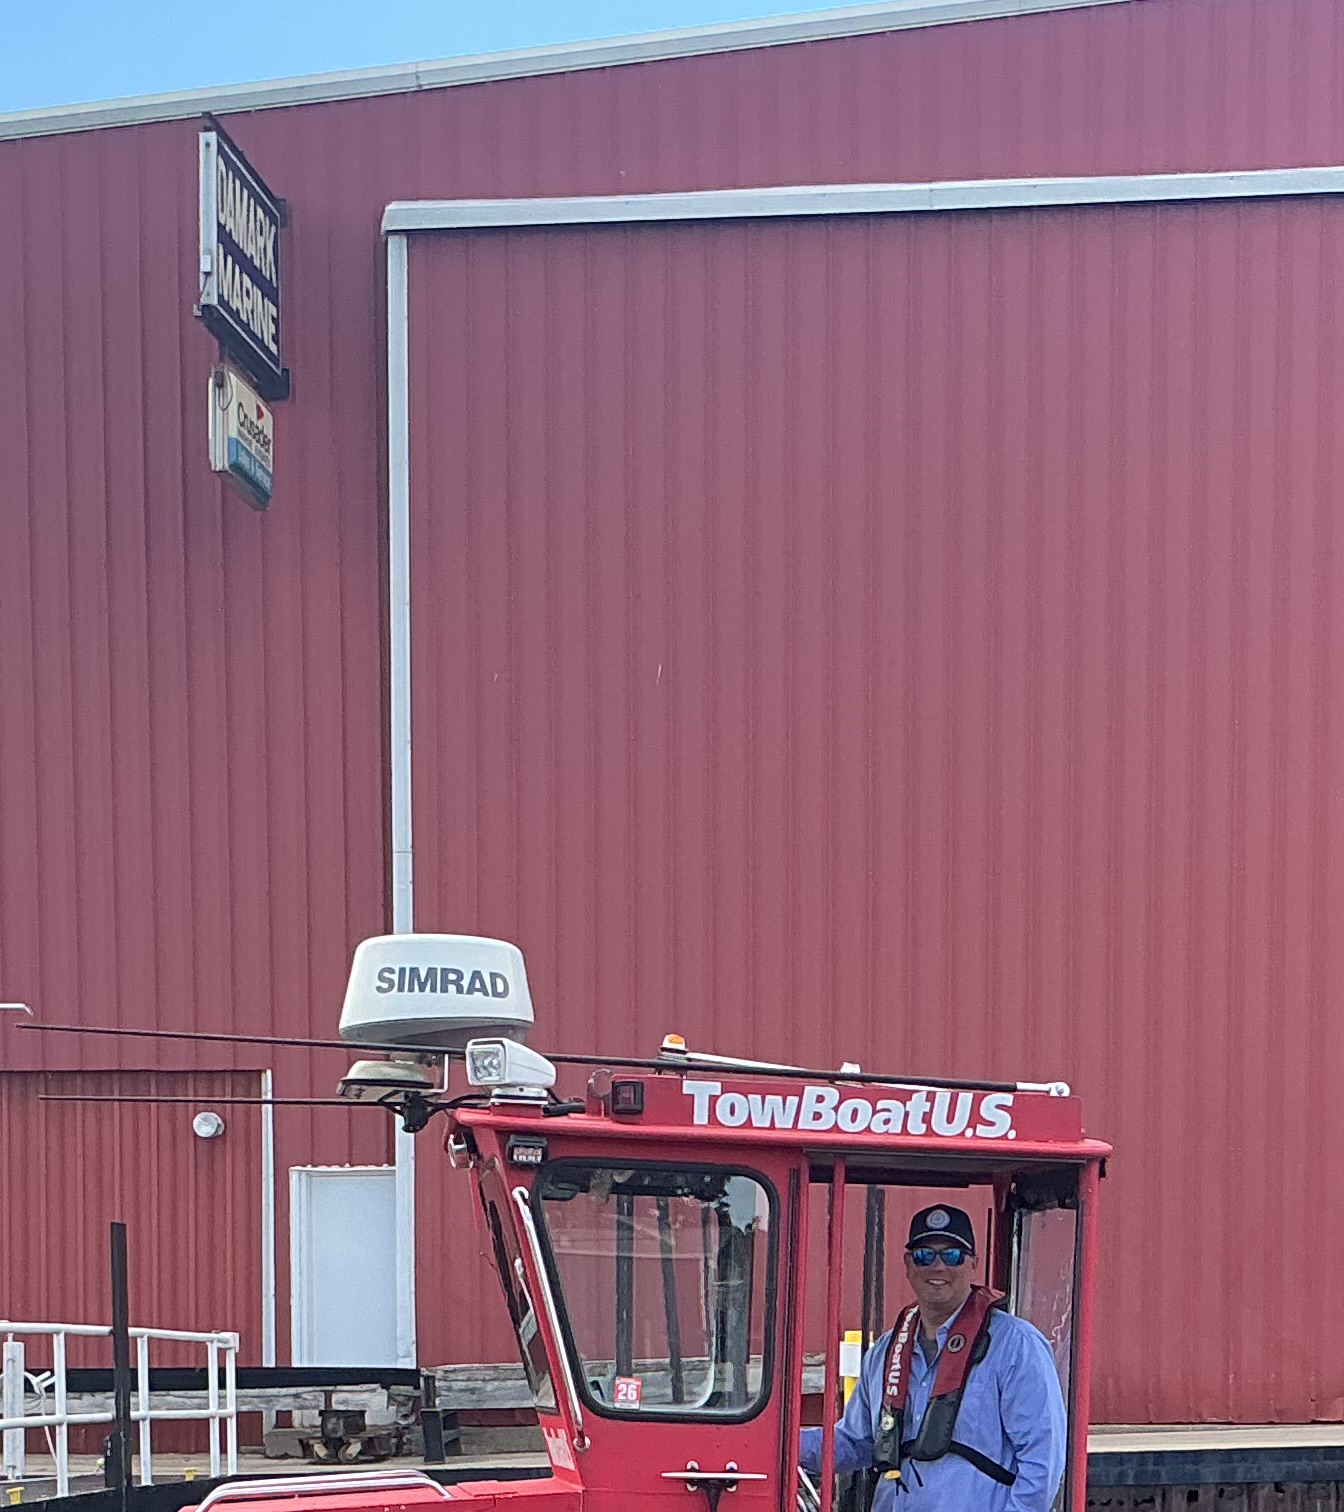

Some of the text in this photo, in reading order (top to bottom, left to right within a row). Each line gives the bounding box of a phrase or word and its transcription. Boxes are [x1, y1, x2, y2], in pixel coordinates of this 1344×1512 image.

[218, 154, 277, 288] DAMARK
[218, 242, 278, 356] MARINE
[375, 966, 510, 999] SIMRAD
[682, 1080, 1017, 1139] TowBoatU.S.
[617, 1383, 638, 1400] 26
